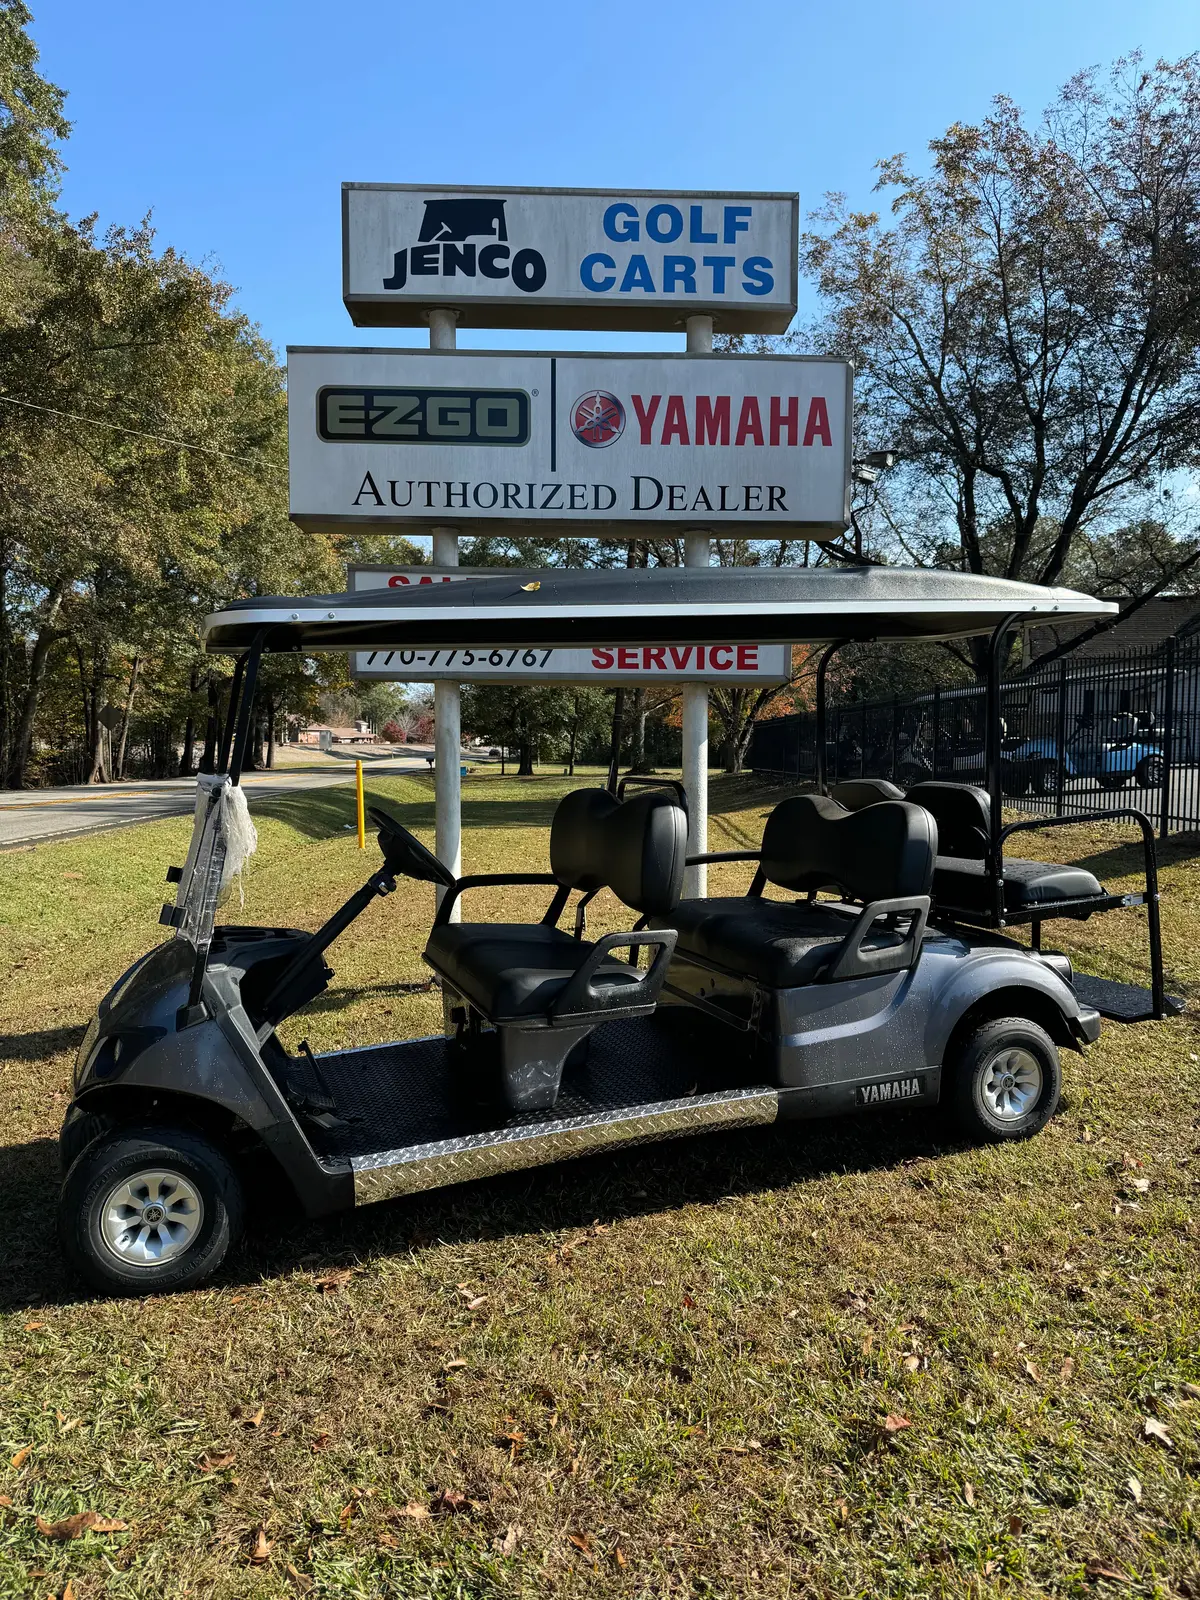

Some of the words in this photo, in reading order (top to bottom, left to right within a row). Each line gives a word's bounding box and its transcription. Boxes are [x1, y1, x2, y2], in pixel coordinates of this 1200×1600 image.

[603, 202, 753, 244] GOLF
[383, 243, 547, 293] JENCO
[579, 252, 774, 296] CARTS
[325, 393, 522, 438] EZGO
[631, 394, 833, 447] YAMAHA
[352, 470, 617, 511] AUTHORIZED
[630, 475, 789, 512] DEALER
[591, 645, 759, 671] SERVICE
[861, 1078, 920, 1103] YAMAHA
